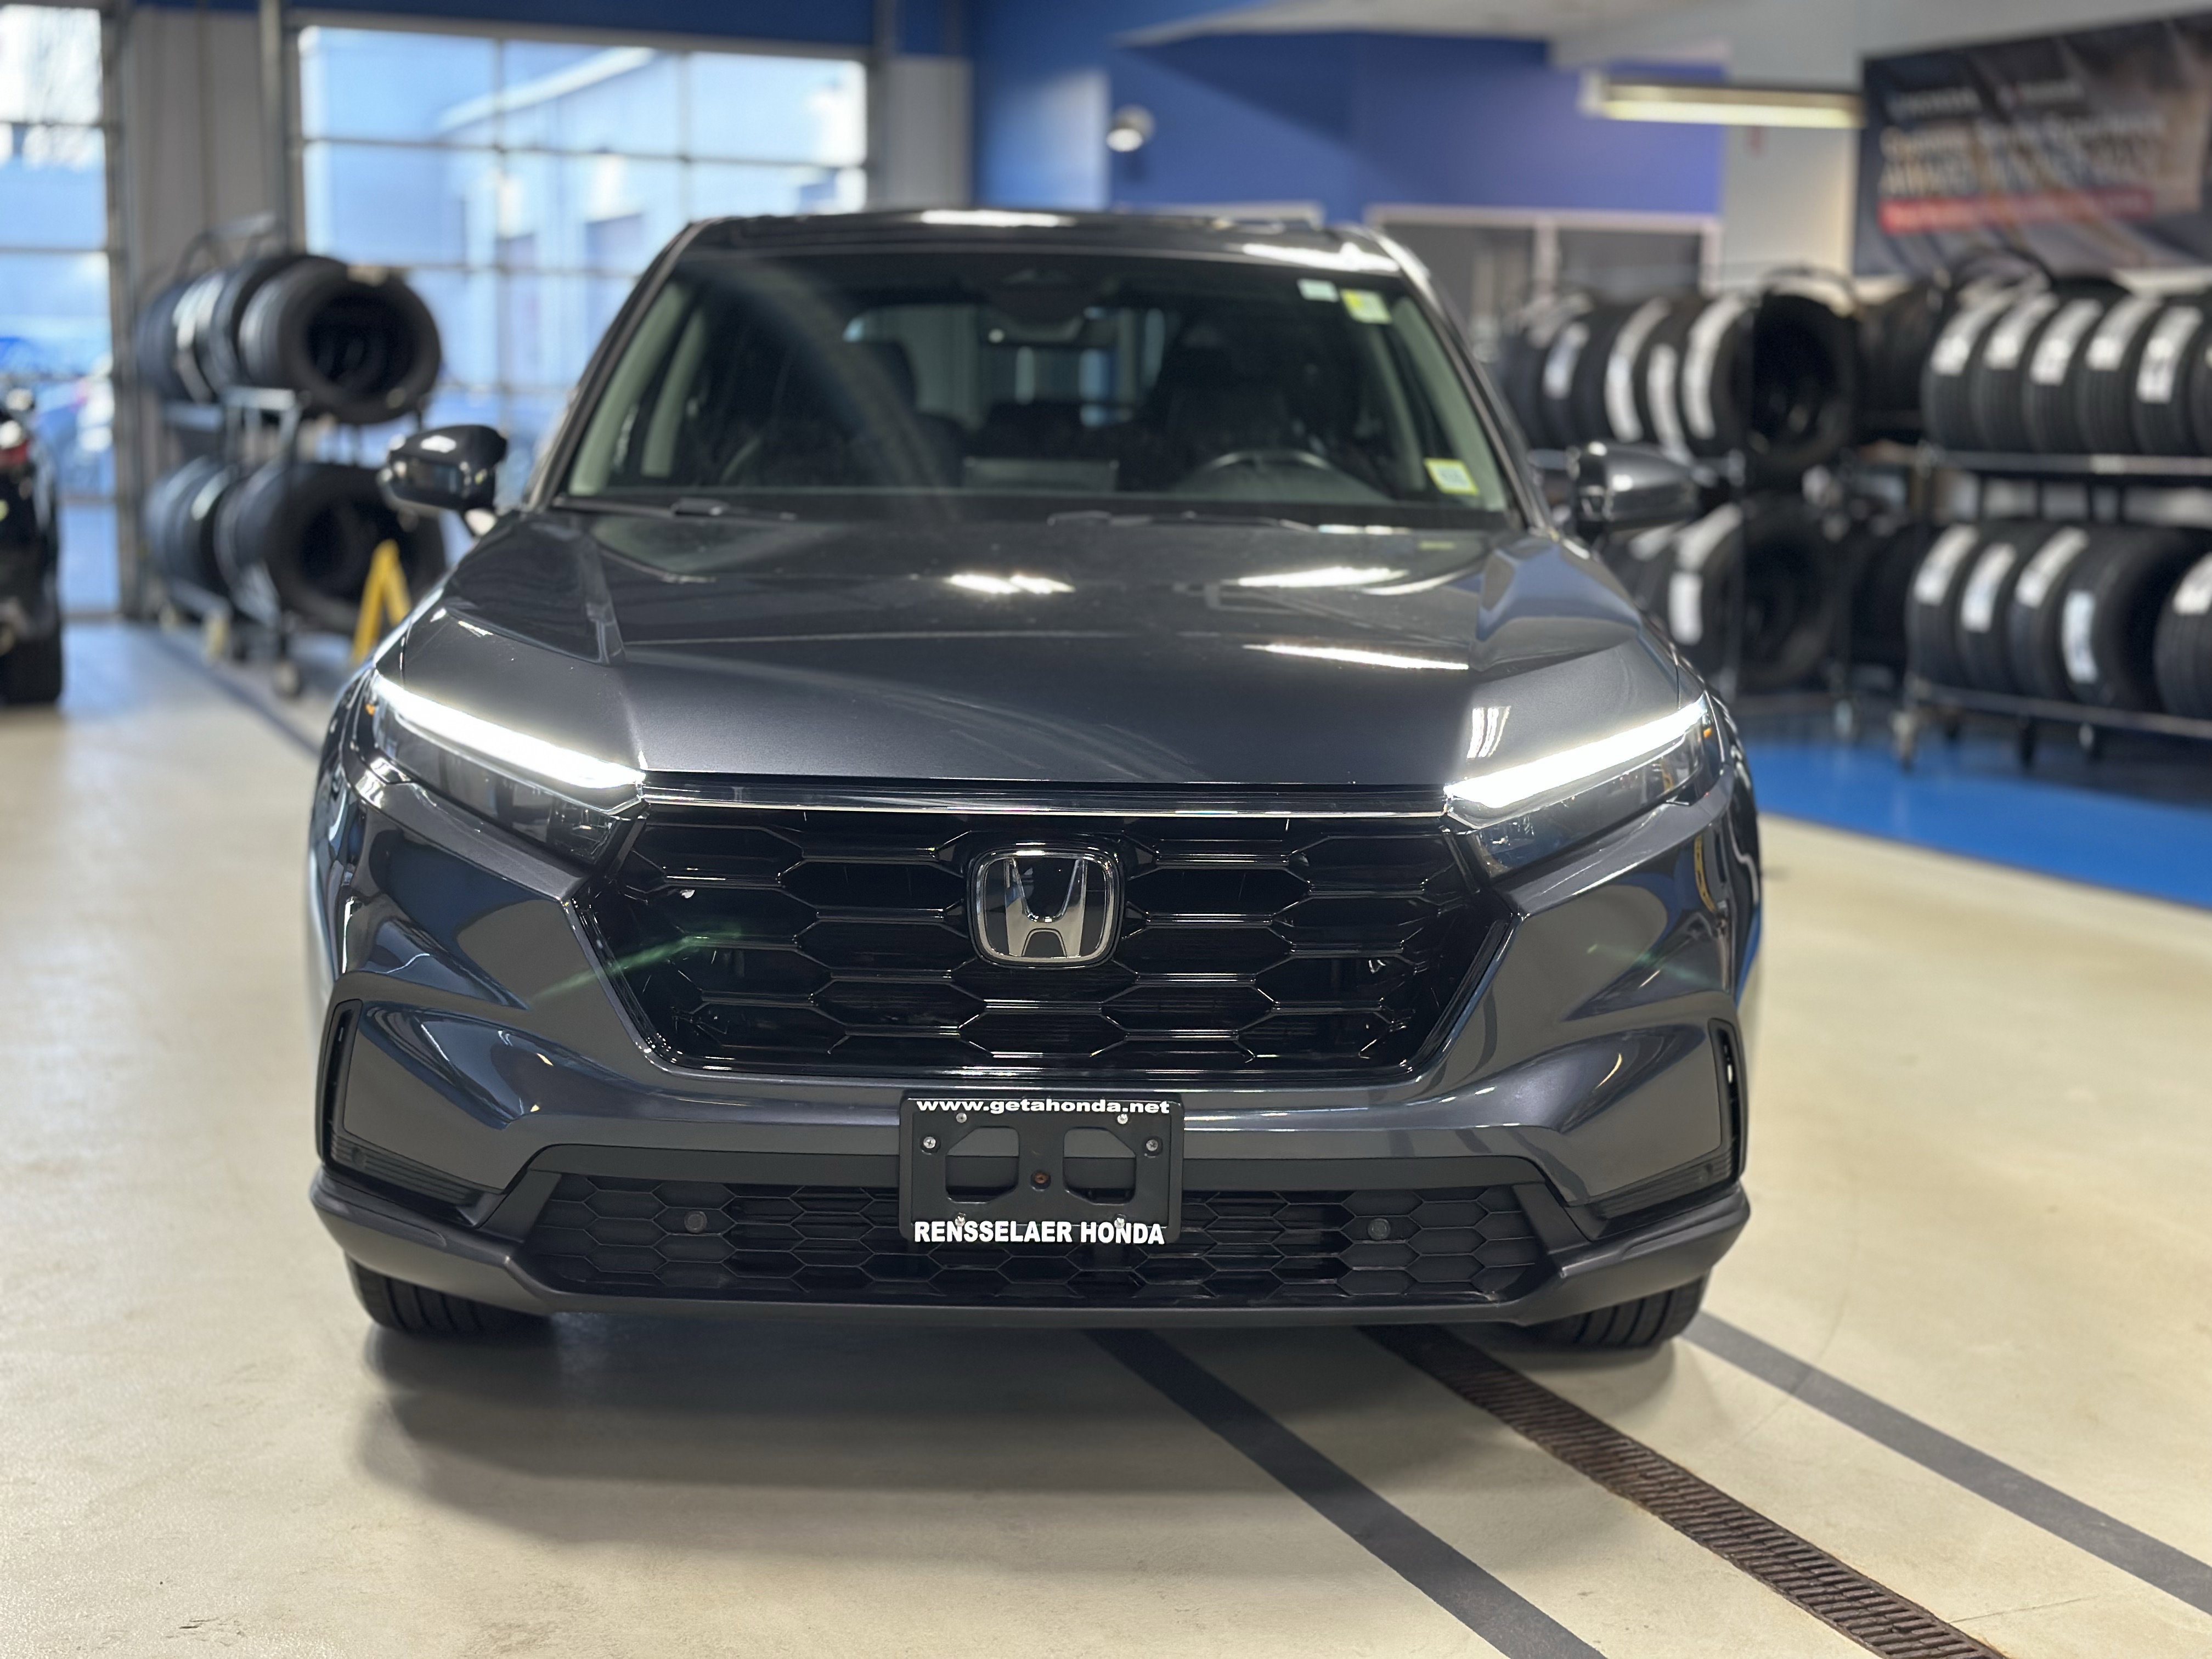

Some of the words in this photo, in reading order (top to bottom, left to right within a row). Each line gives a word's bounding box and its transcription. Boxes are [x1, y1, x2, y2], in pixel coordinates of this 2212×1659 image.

[916, 1099, 1170, 1114] www.getahonda.net
[914, 1221, 1073, 1242] RENSSELAER
[1080, 1221, 1165, 1244] HONDA
